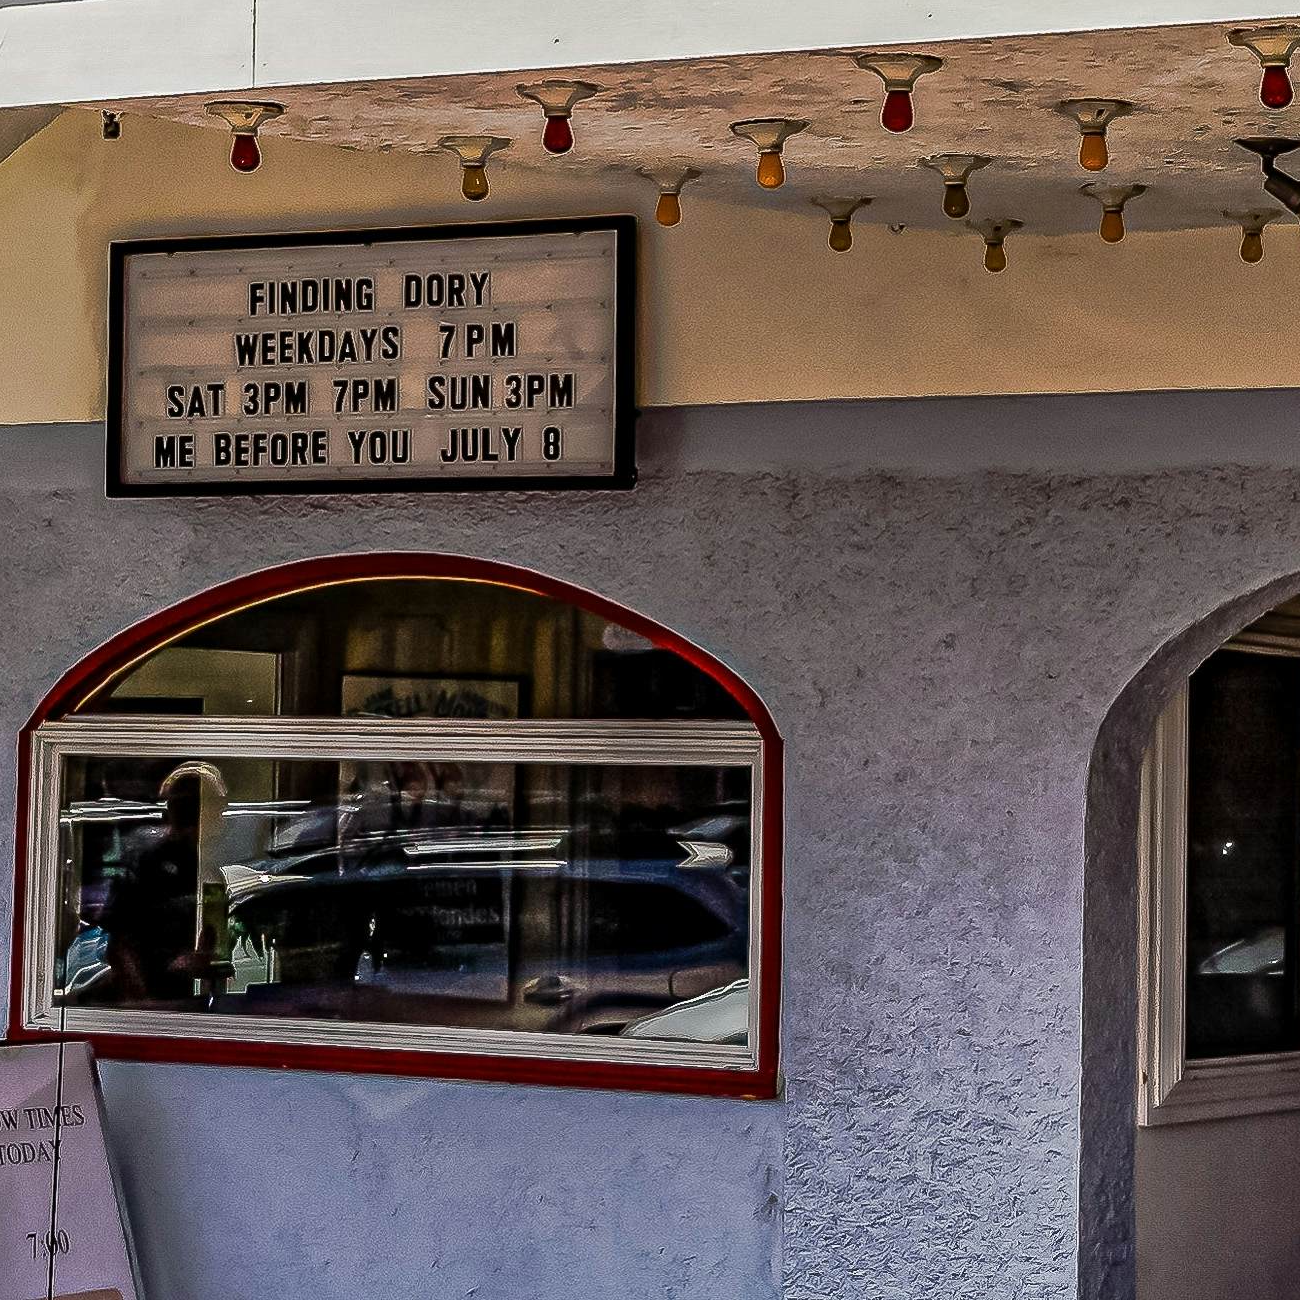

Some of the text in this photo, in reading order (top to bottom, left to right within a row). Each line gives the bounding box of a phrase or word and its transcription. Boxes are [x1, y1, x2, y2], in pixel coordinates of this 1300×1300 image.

[249, 271, 490, 316] FINDING DORY
[235, 325, 400, 367] WEEKDAYS
[167, 371, 575, 419] SAT 3PM 7PM SUN 3PM
[154, 424, 562, 469] ME BEFORE YOU JULY 8
